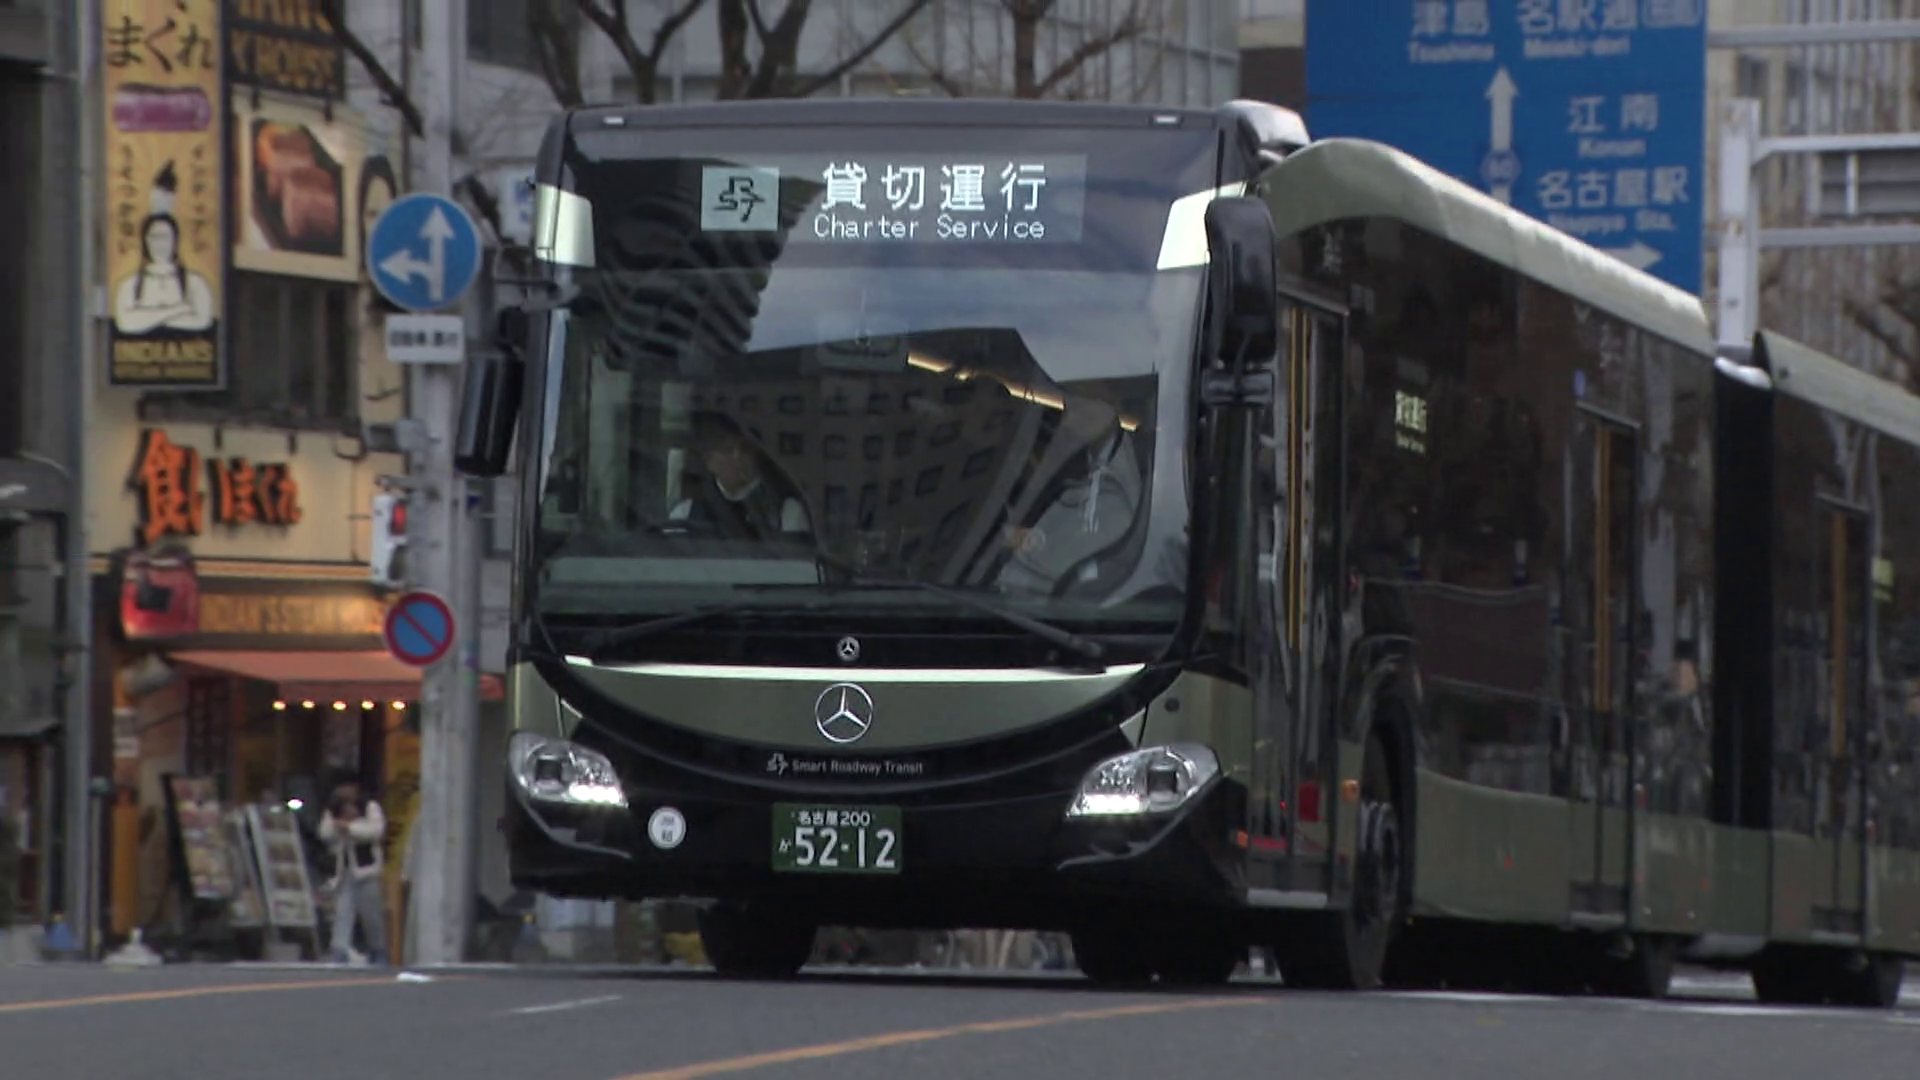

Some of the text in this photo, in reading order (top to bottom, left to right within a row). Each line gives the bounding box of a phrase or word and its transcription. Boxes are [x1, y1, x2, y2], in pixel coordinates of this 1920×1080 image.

[1412, 0, 1491, 36] 津島
[1408, 40, 1495, 63] Tsushima
[1524, 35, 1631, 57] Meieki-dori
[1568, 94, 1658, 132] 江南
[1578, 138, 1647, 157] Konan
[821, 161, 1047, 212] 貸切運行
[1537, 167, 1689, 209] 名古屋駅
[813, 213, 1046, 239] Charter Service
[1635, 208, 1676, 231] Sta.
[792, 759, 827, 773] Smart
[831, 759, 882, 776] Roadway
[885, 760, 924, 774] Transit
[795, 826, 896, 868] 52-12
